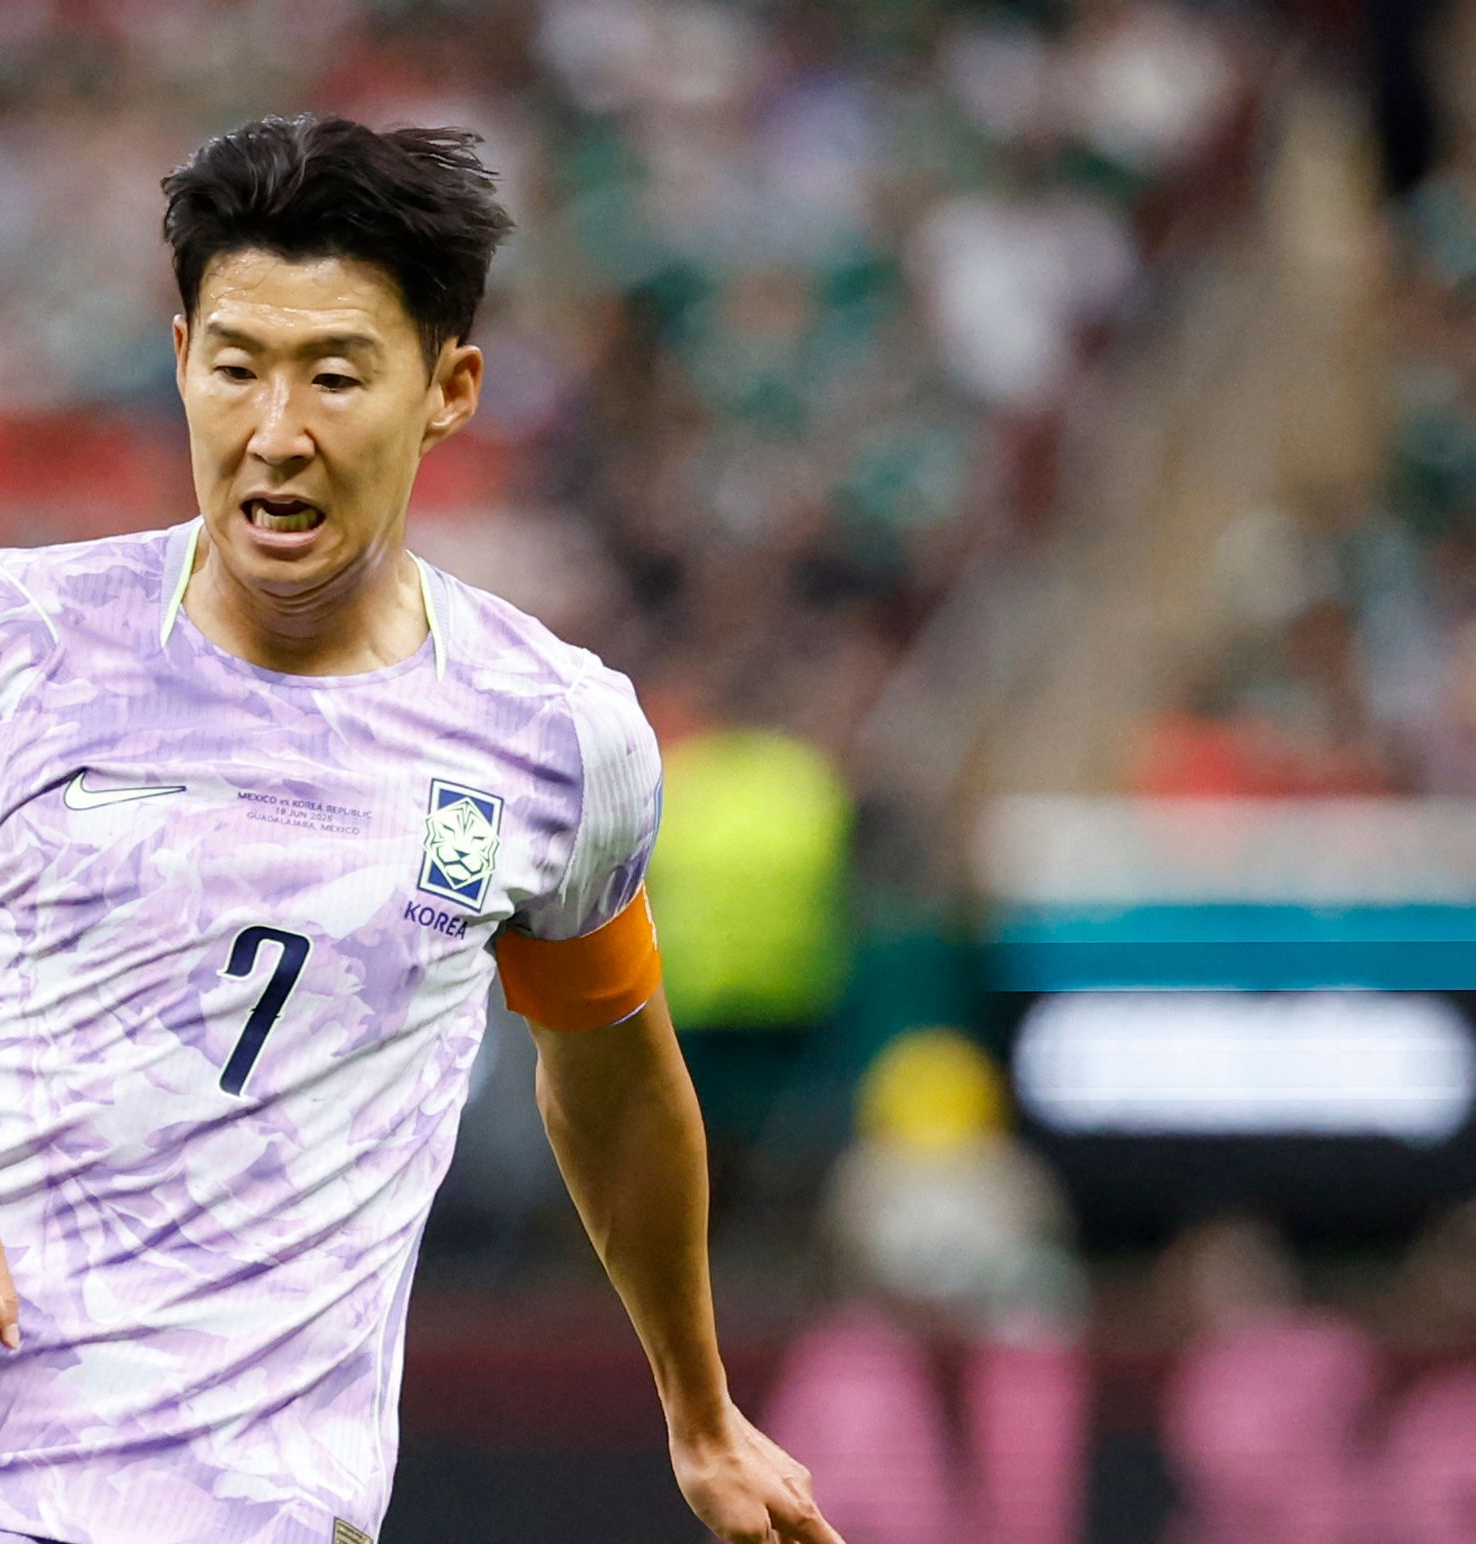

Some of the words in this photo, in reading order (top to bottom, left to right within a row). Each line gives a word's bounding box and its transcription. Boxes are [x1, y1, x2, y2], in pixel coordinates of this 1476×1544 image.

[237, 791, 277, 805] MEXICO
[292, 800, 323, 812] KOREA
[326, 804, 373, 820] REPUBLIC
[289, 810, 307, 819] JUN
[320, 823, 360, 836] MEXICO
[404, 900, 468, 940] KOREA
[217, 925, 311, 1099] 7
